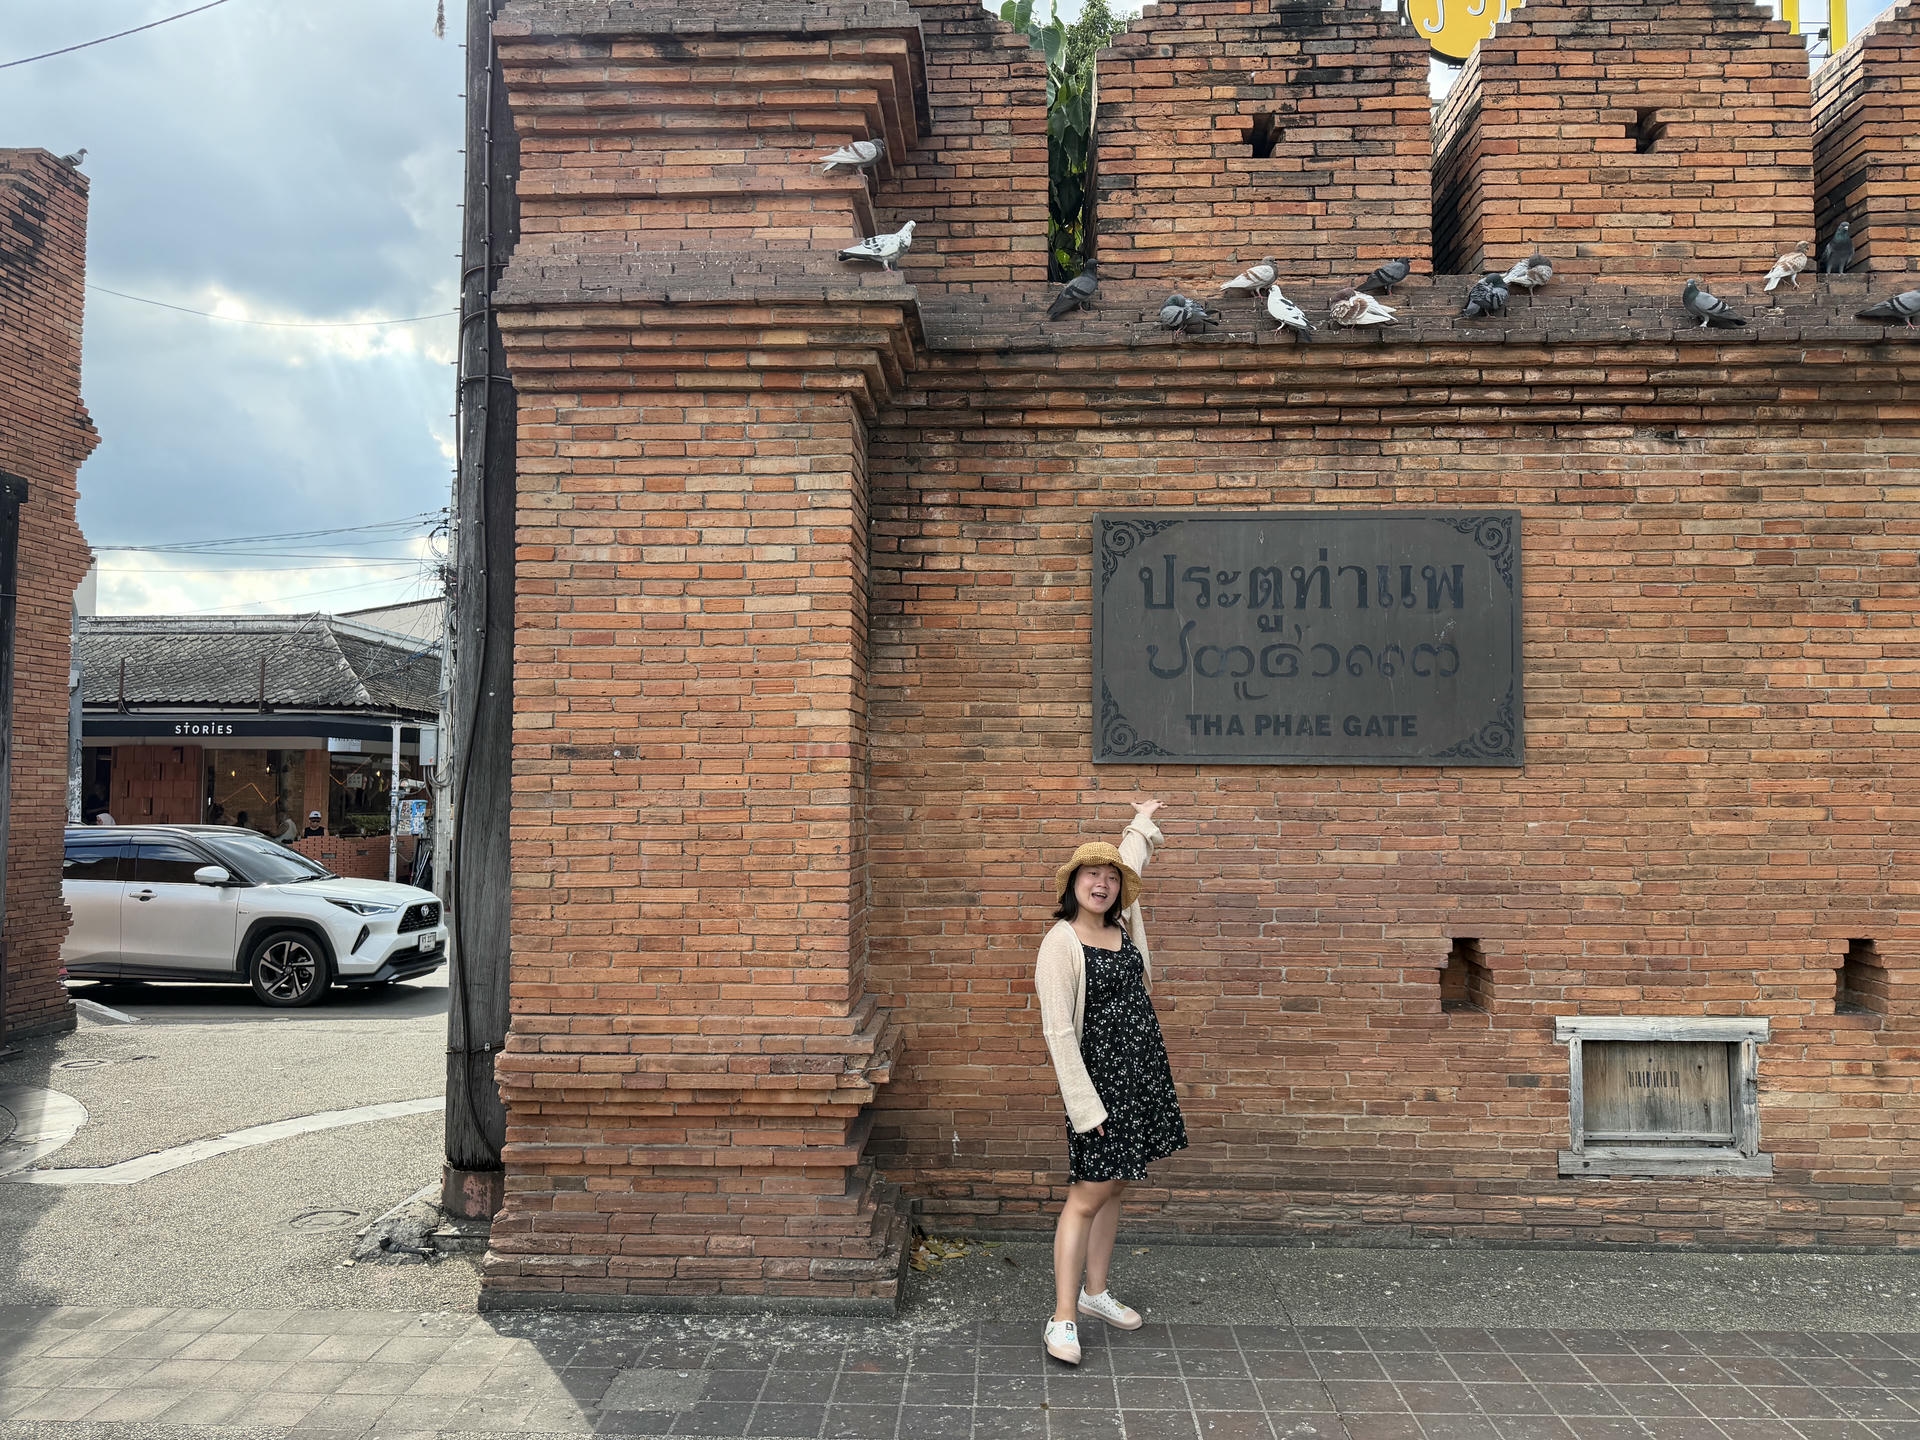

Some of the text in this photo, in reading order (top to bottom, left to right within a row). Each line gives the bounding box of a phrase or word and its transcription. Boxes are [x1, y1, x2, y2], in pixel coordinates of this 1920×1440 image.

[1138, 547, 1465, 633] ประตูท่าแพ
[1185, 714, 1418, 737] THA PHAE GATE
